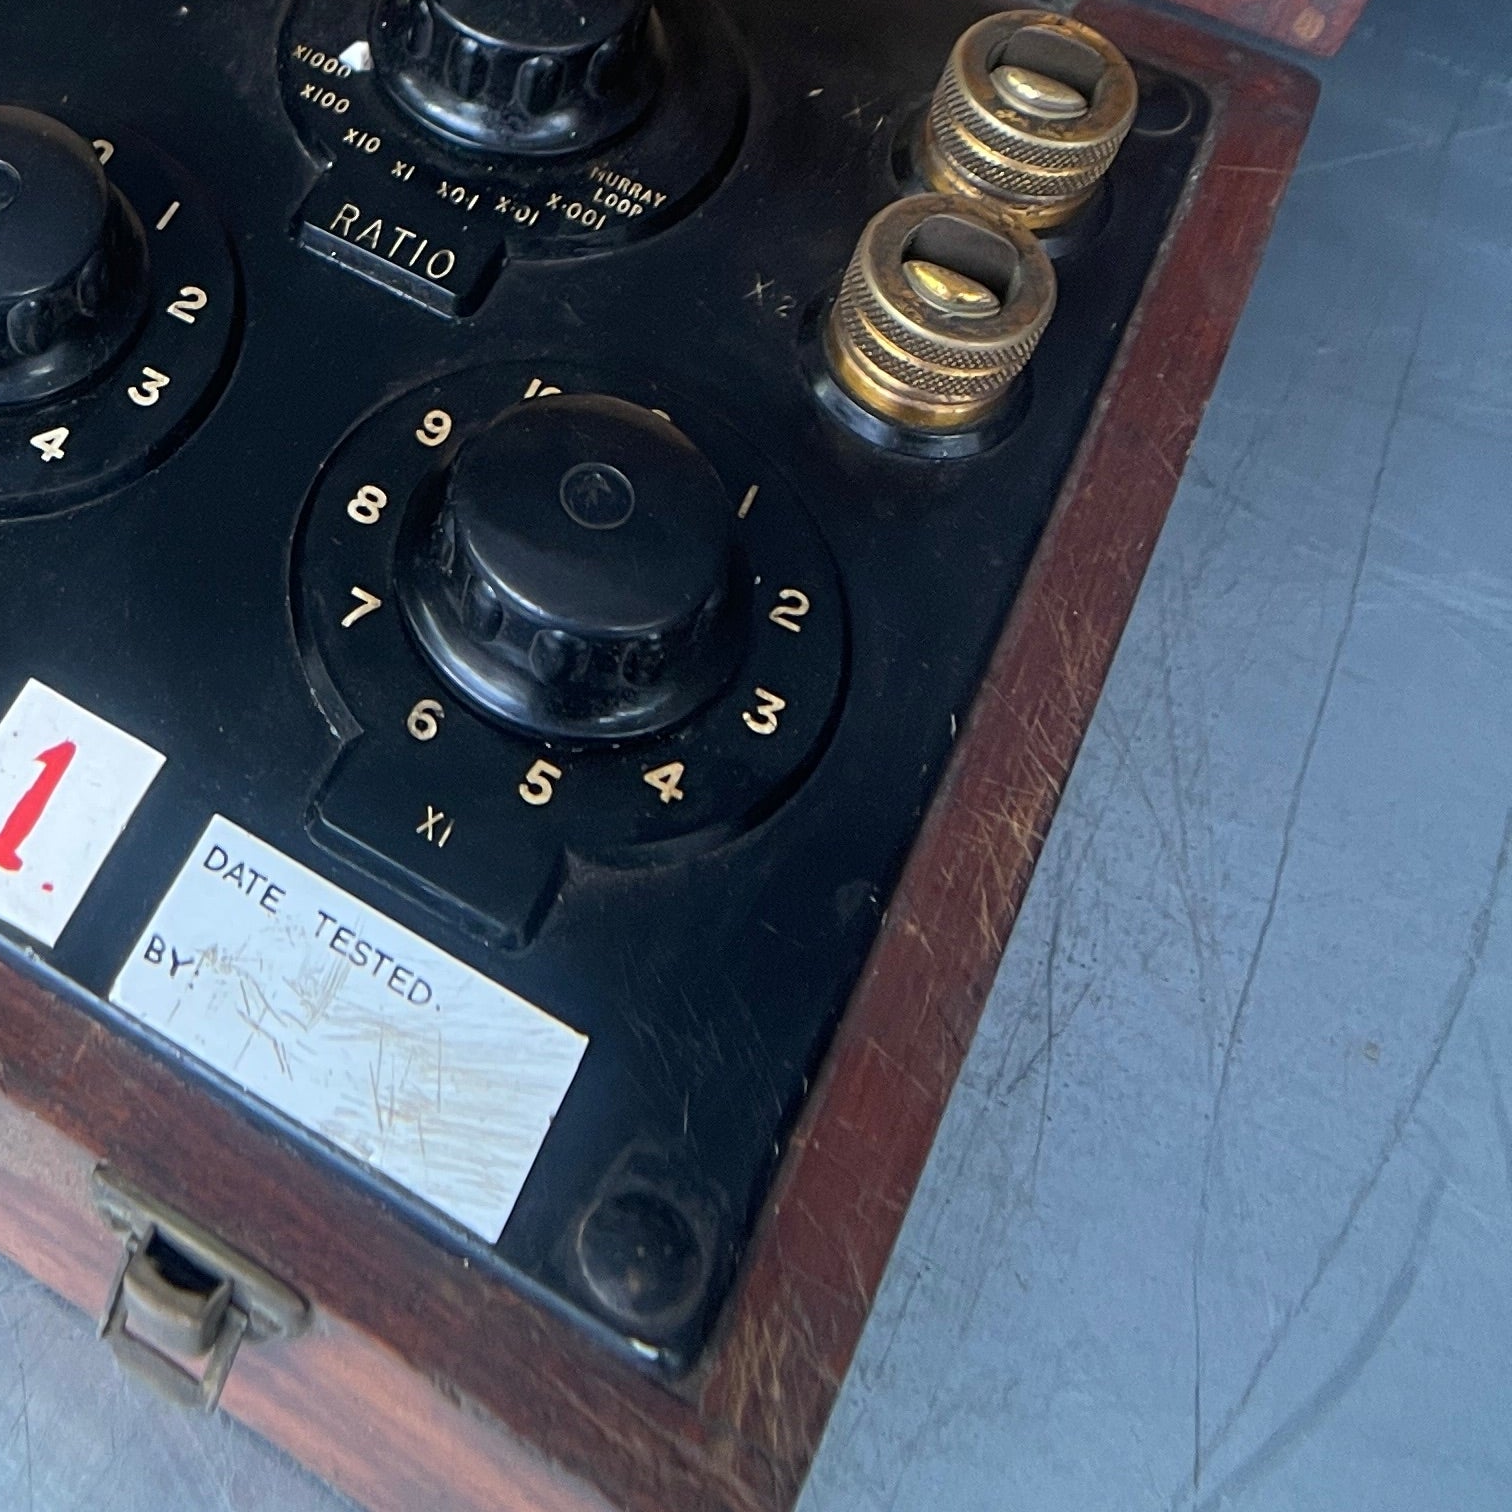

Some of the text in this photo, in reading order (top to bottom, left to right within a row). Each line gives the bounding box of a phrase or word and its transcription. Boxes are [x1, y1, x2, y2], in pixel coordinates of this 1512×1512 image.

[299, 83, 351, 114] X100
[343, 127, 381, 154] X10
[590, 164, 667, 209] MURRAY
[592, 187, 643, 218] LOOP
[155, 201, 181, 230] 1
[329, 203, 456, 280] RATIO
[166, 285, 208, 324] 2
[127, 366, 170, 407] 3
[30, 425, 70, 463] 4
[414, 409, 453, 447] 9
[346, 484, 388, 526] 8
[736, 484, 759, 519] 1
[341, 585, 383, 629] 7
[768, 587, 811, 633] 2
[405, 697, 446, 743] 6
[741, 687, 786, 736] 3
[518, 758, 562, 806] 5
[642, 760, 686, 805] 4
[415, 805, 455, 848] X1
[202, 843, 288, 914] DATE
